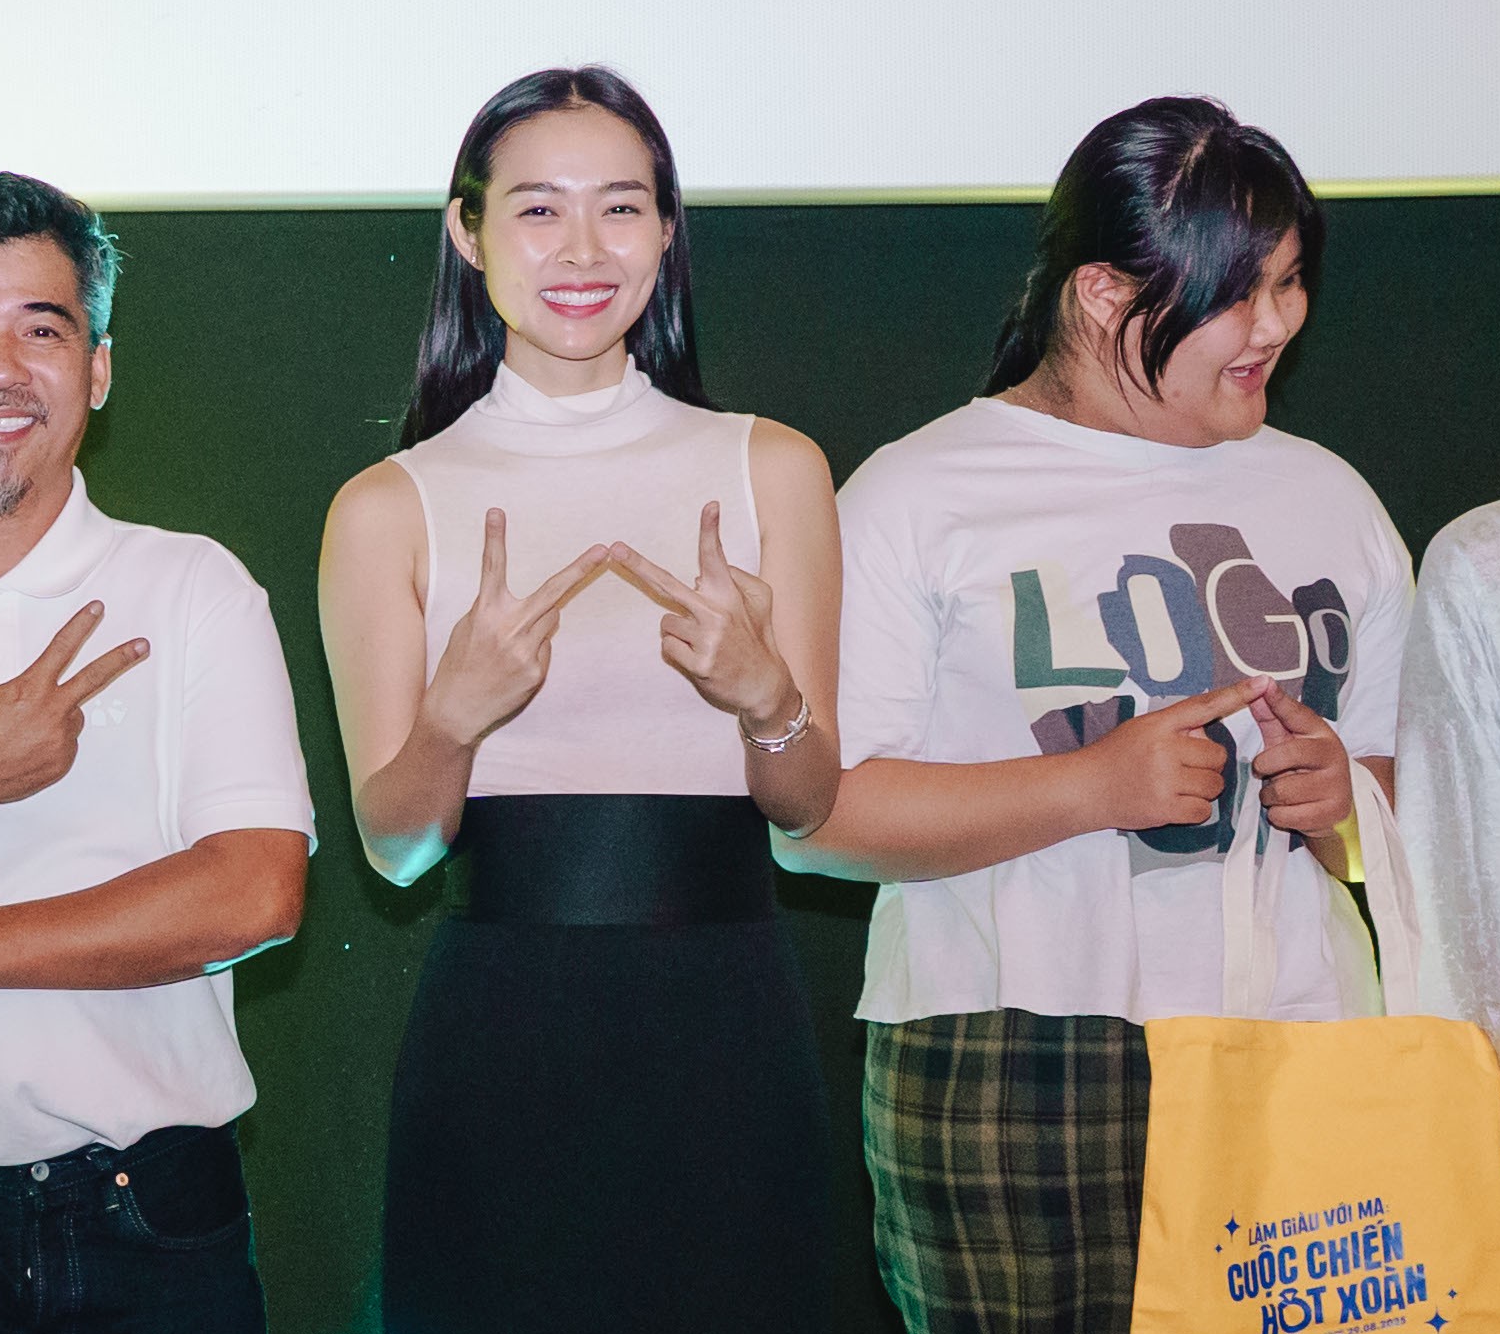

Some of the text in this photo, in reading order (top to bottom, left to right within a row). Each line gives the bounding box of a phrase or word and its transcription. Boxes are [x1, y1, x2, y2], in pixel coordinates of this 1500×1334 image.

[1227, 1219, 1405, 1302] CUỘC CHIẾN
[1248, 1222, 1277, 1246] LÀM
[1337, 1263, 1428, 1324] XOÀN
